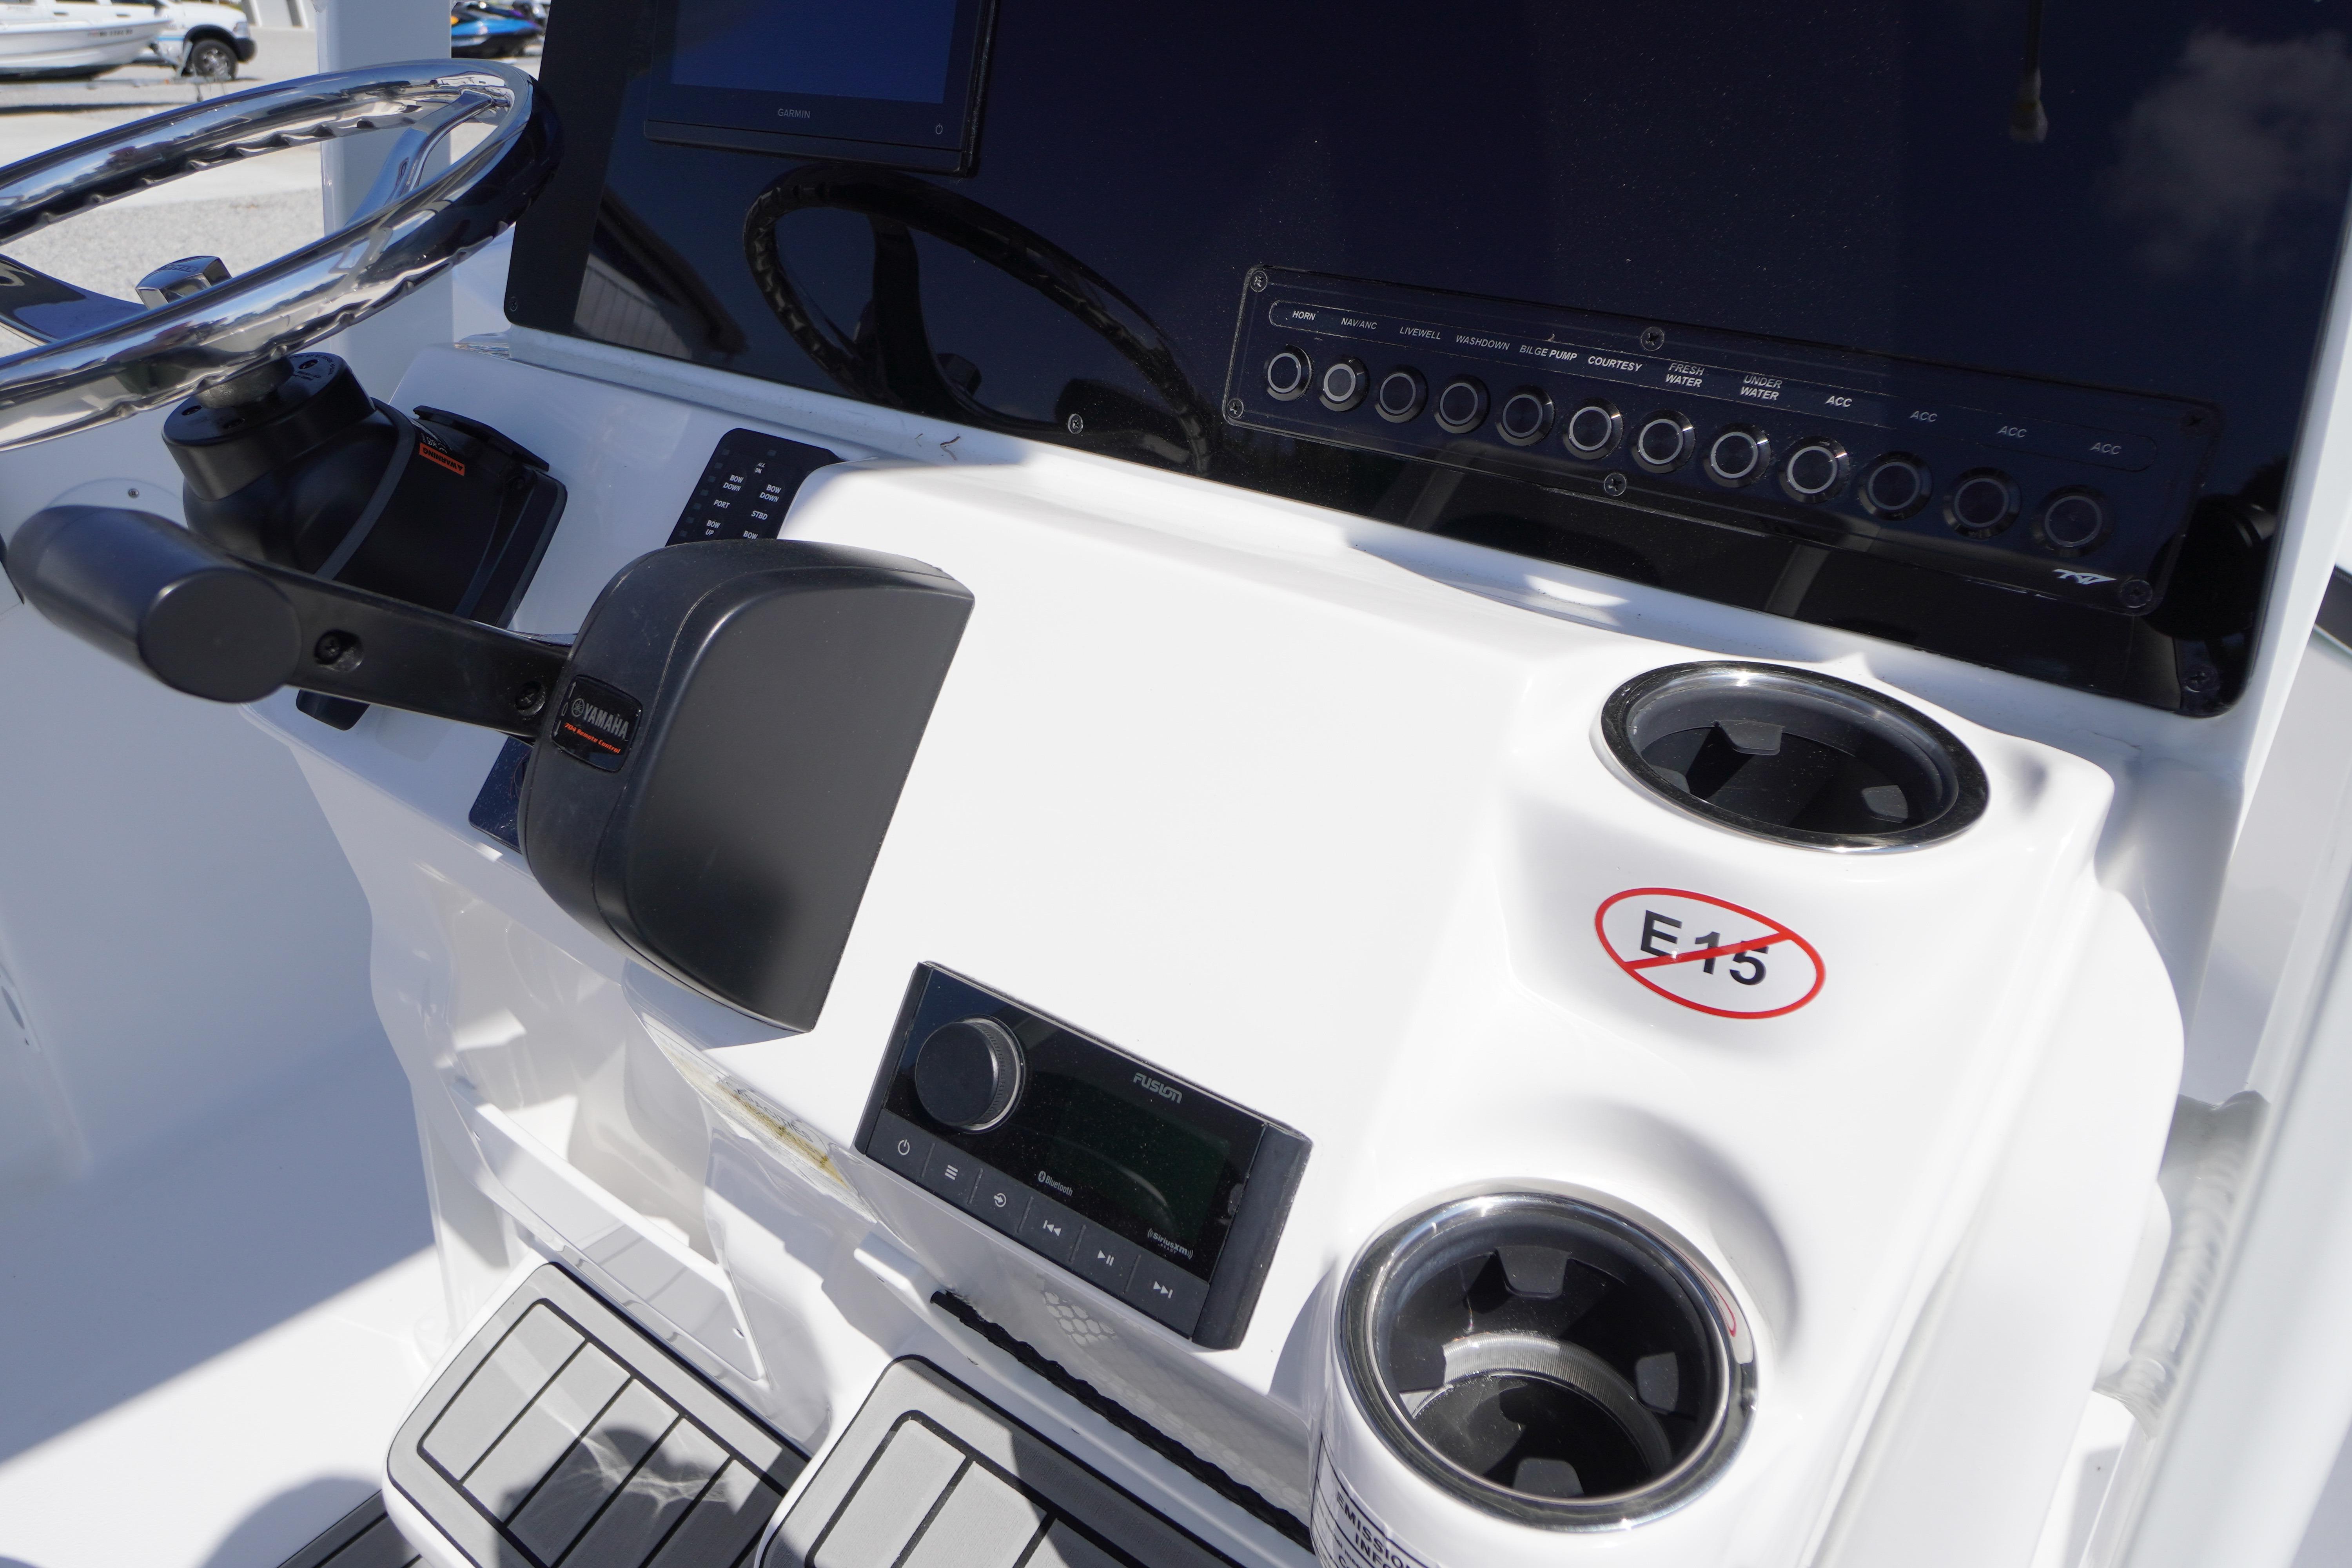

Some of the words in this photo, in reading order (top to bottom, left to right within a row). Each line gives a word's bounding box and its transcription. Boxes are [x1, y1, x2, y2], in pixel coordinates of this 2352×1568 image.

[778, 108, 810, 118] GARMIN
[1292, 311, 1316, 321] HORN
[1341, 318, 1377, 330] NAV/ANC
[1399, 327, 1441, 339] LIVEWELL
[1456, 335, 1510, 350] WASHDOWN
[1520, 345, 1547, 357] BILGE
[1549, 349, 1577, 361] PUMP
[1588, 356, 1642, 372] COURTESY
[1668, 362, 1704, 376] FRESH
[1666, 373, 1702, 387] WATER
[1743, 374, 1782, 389] UNDER
[1740, 386, 1779, 401] WATER
[1826, 396, 1853, 407] ACC
[1909, 410, 1938, 422] ACC
[1996, 426, 2027, 438] ACC
[2090, 442, 2121, 455] ACC
[423, 448, 457, 470] WARNING
[730, 475, 744, 483] BOW
[723, 482, 741, 492] DOWN
[766, 484, 782, 494] BOW
[759, 492, 779, 502] DOWN
[713, 499, 730, 508] PORT
[751, 510, 768, 520] STBD
[706, 520, 721, 528] BOW
[743, 530, 759, 539] BOW
[584, 703, 629, 740] YAMAHA
[576, 729, 598, 743] Remote
[598, 740, 621, 753] Control
[1133, 1072, 1183, 1104] FUSION
[1045, 1175, 1073, 1196] Bluetooth
